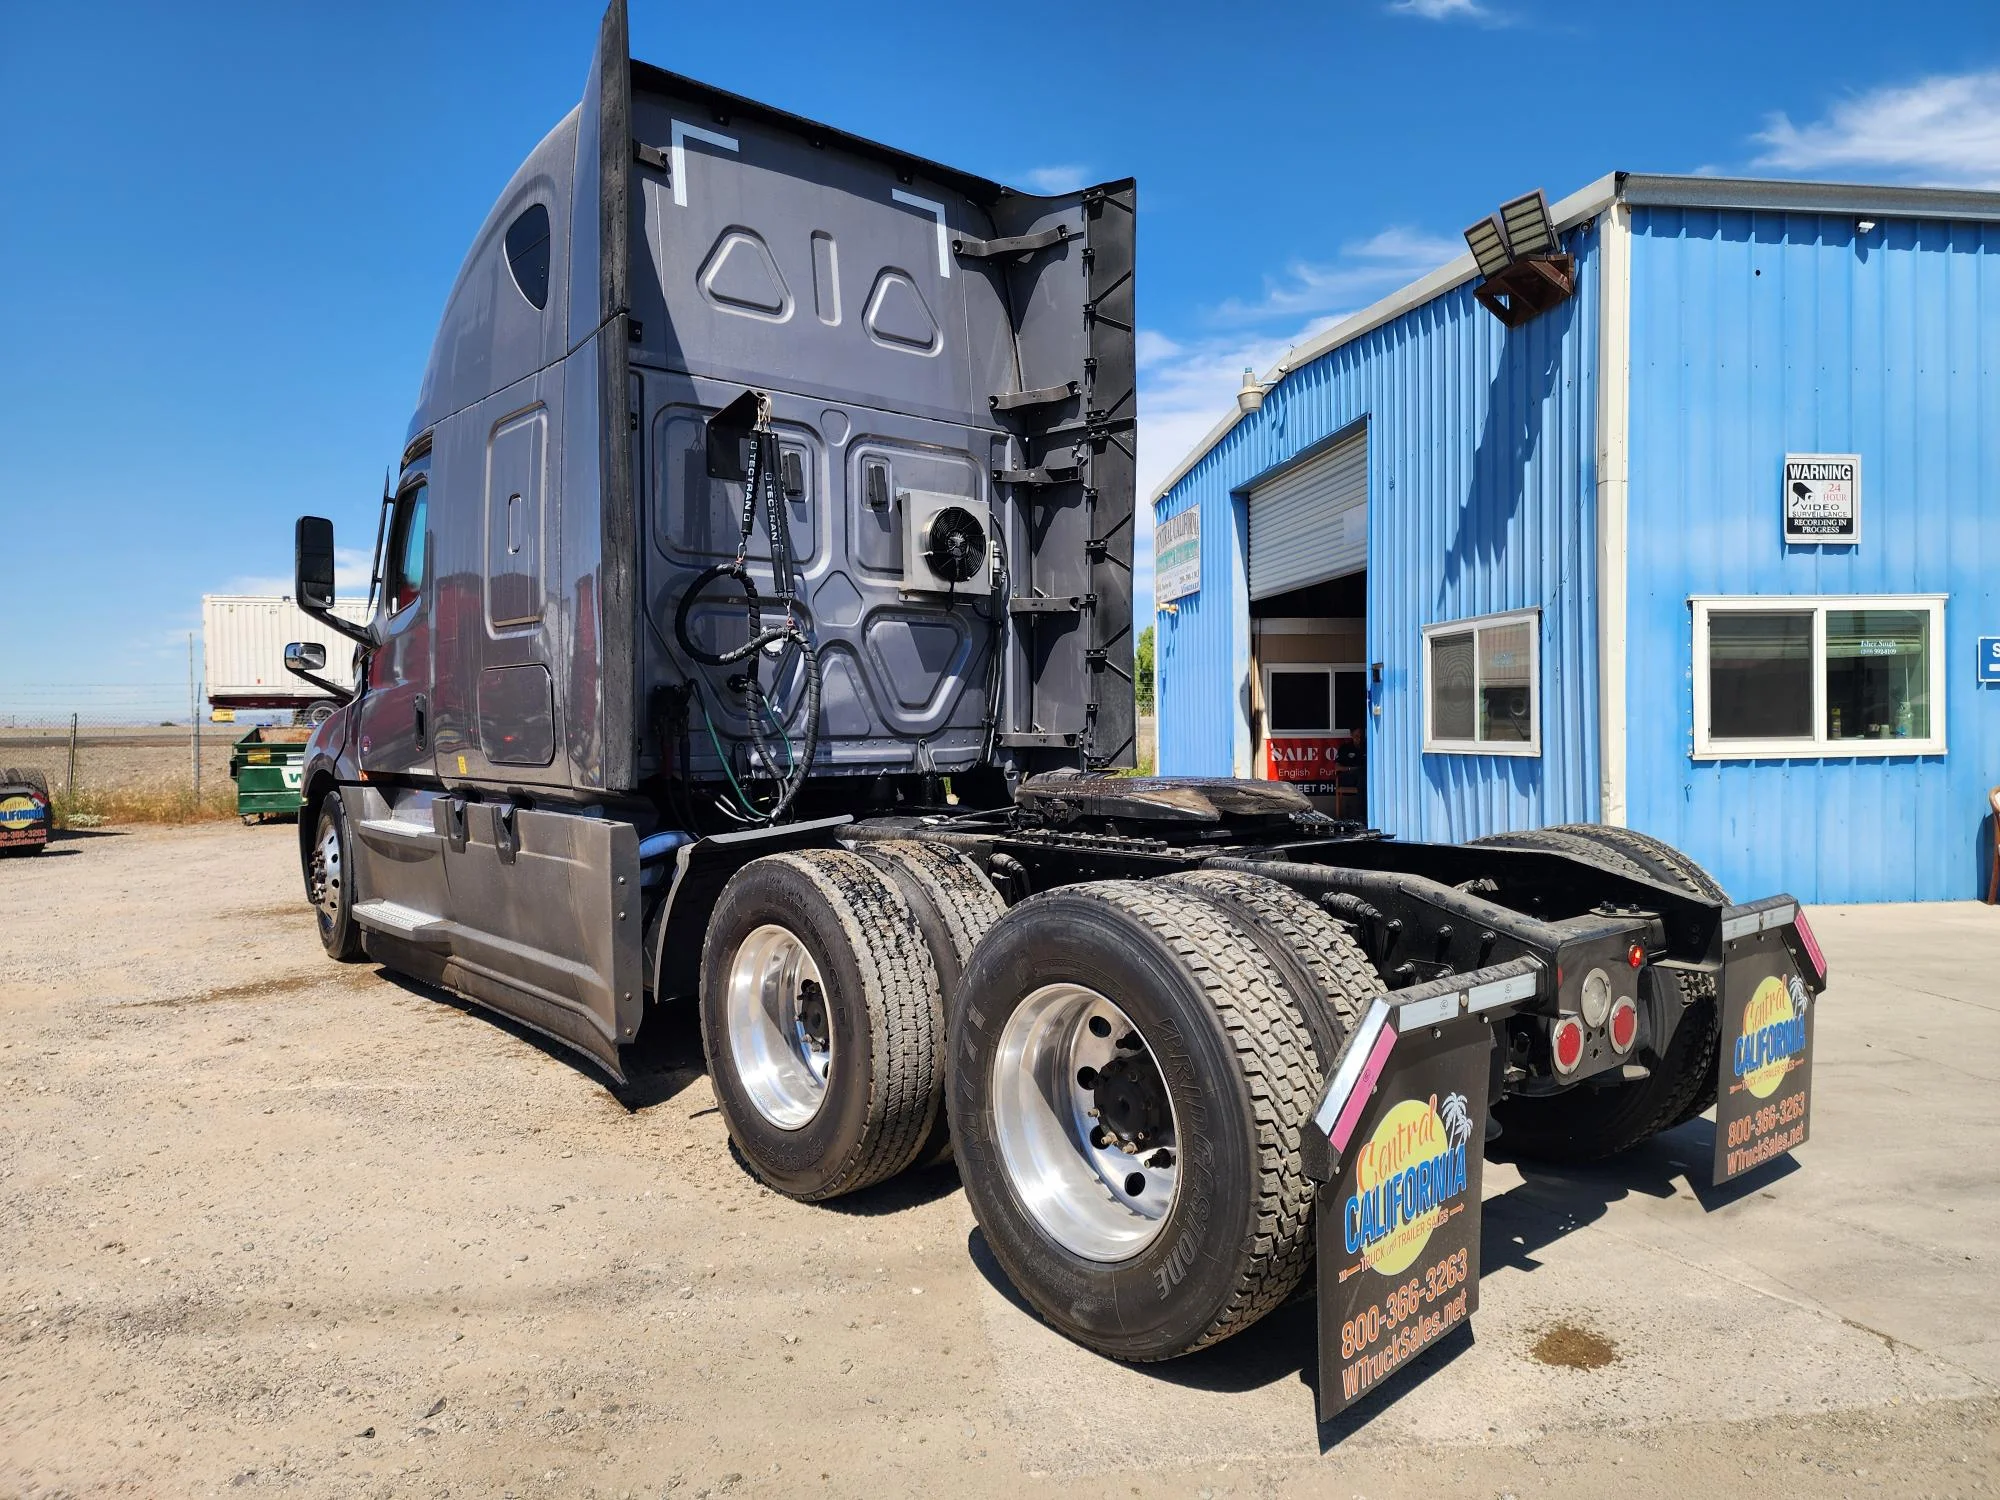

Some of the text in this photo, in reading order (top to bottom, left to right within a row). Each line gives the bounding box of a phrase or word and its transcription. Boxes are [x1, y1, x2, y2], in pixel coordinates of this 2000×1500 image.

[744, 453, 756, 510] TECTRAN
[1789, 464, 1851, 480] WARNING
[1823, 493, 1847, 501] HOUR
[1829, 483, 1841, 493] 24
[766, 484, 778, 542] TECTRAN
[1793, 518, 1847, 526] RECORDING IN
[1800, 503, 1840, 511] VIDEO
[1802, 526, 1840, 534] PROGRESS
[1271, 747, 1319, 762] SALE
[1278, 767, 1311, 779] English
[1294, 783, 1317, 793] EET
[1742, 973, 1788, 1036] Central
[1734, 1013, 1806, 1077] CALIFORNIA
[1356, 1093, 1438, 1194] Central
[1727, 1091, 1805, 1148] 800-366-3263
[1727, 1120, 1804, 1176] WTruckSales.net
[1344, 1143, 1467, 1255] CALIFORNIA
[1360, 1246, 1385, 1273] TRUCK
[1397, 1223, 1425, 1251] TRAILER
[1426, 1208, 1449, 1231] SALES
[1341, 1247, 1468, 1360] 800-366-3263
[1341, 1287, 1467, 1401] WTruckSales.net
